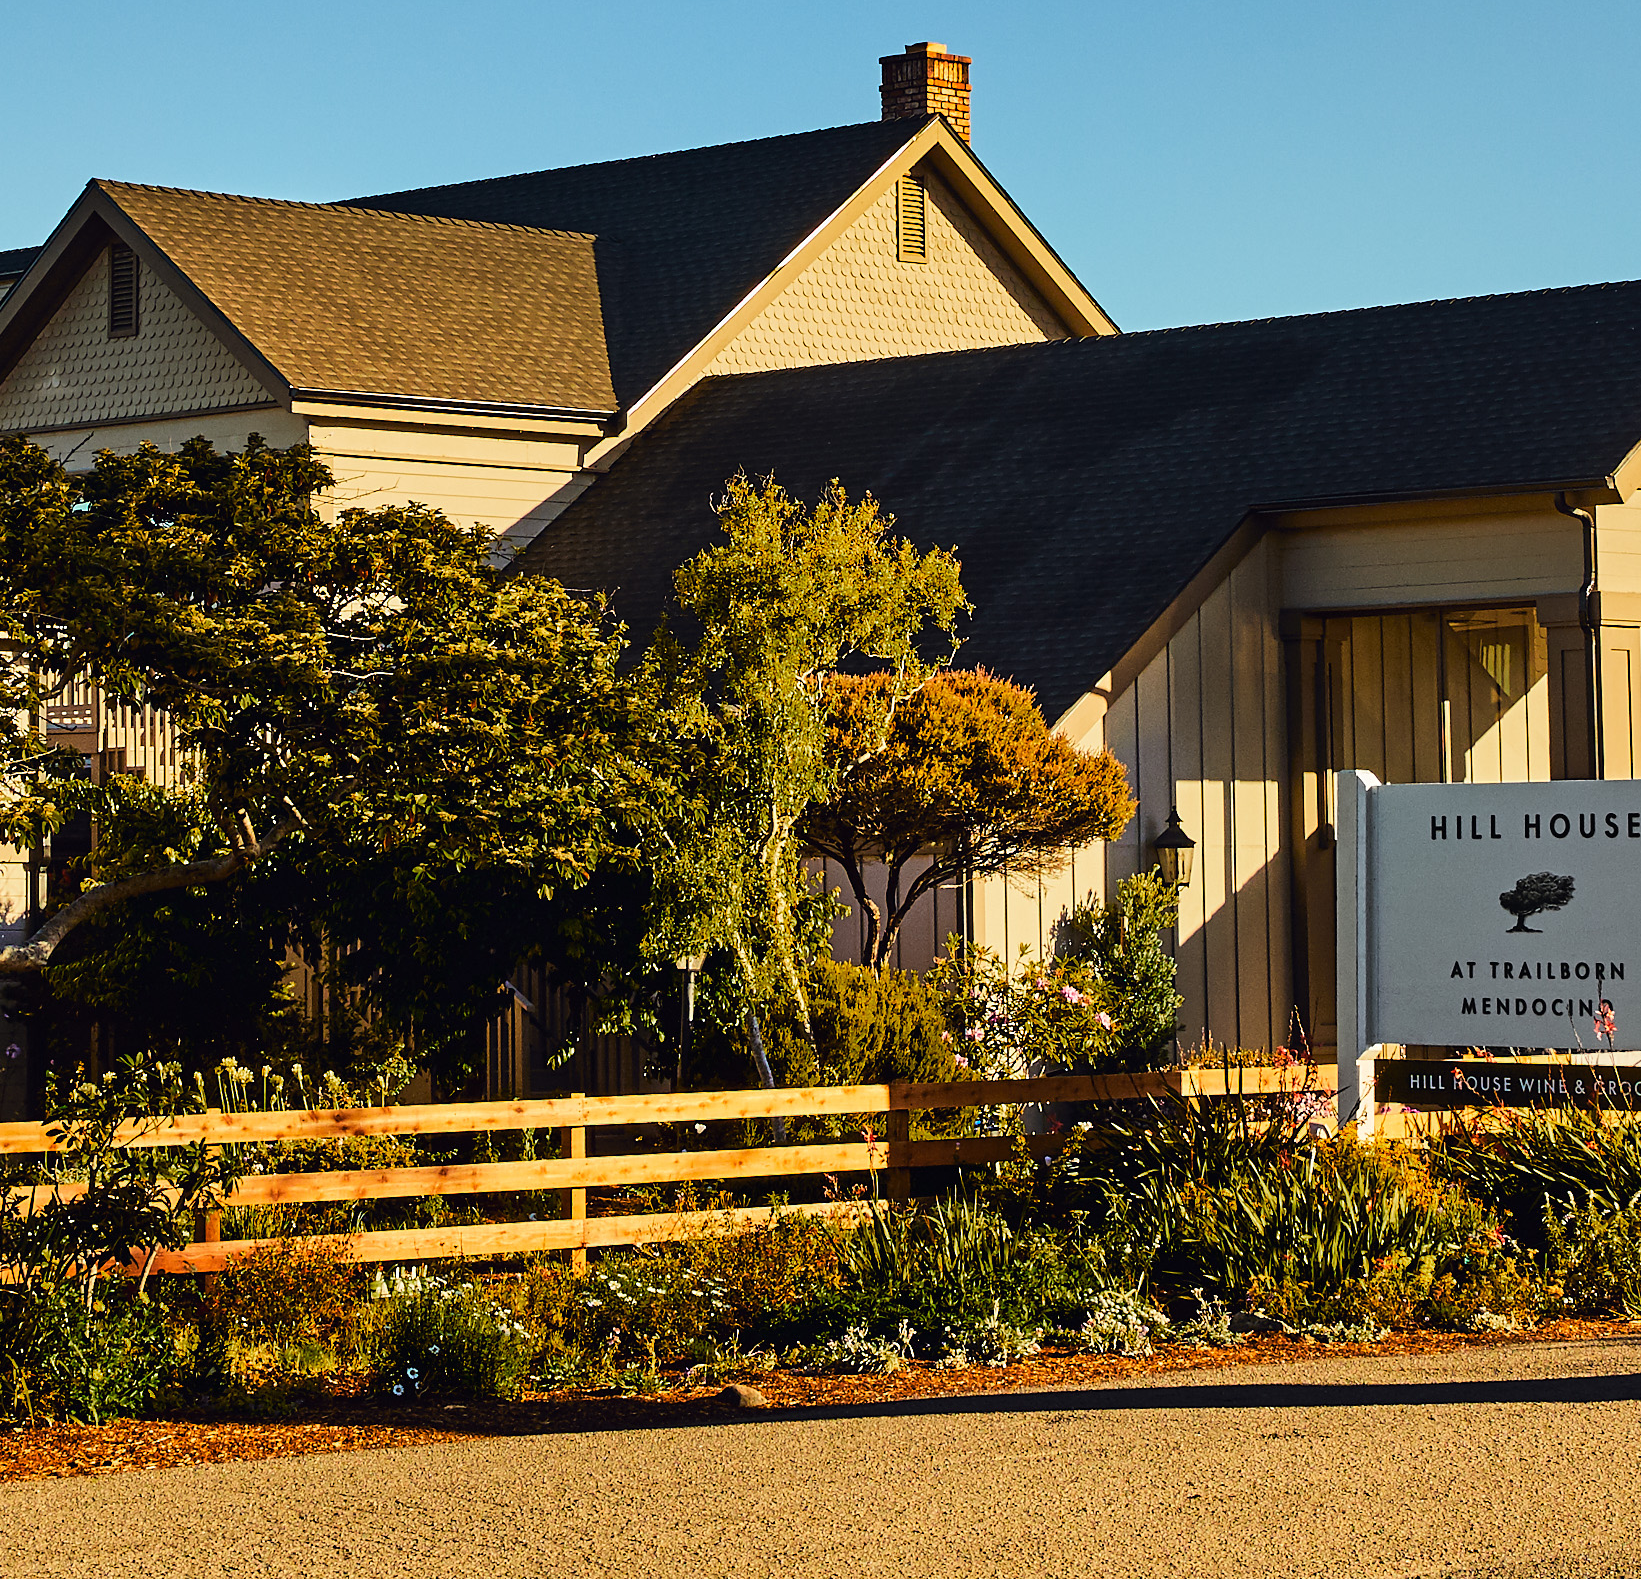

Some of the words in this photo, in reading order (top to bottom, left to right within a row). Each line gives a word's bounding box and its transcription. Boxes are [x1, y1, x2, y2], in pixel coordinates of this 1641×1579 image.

[1430, 814, 1502, 841] HILL
[1524, 812, 1641, 839] HOUSE
[1450, 960, 1477, 979] AT
[1489, 960, 1625, 981] TRAILBORN
[1410, 1074, 1446, 1090] HILL
[1453, 1075, 1512, 1092] HOUSE
[1519, 1077, 1566, 1094] WINE
[1574, 1079, 1586, 1094] &
